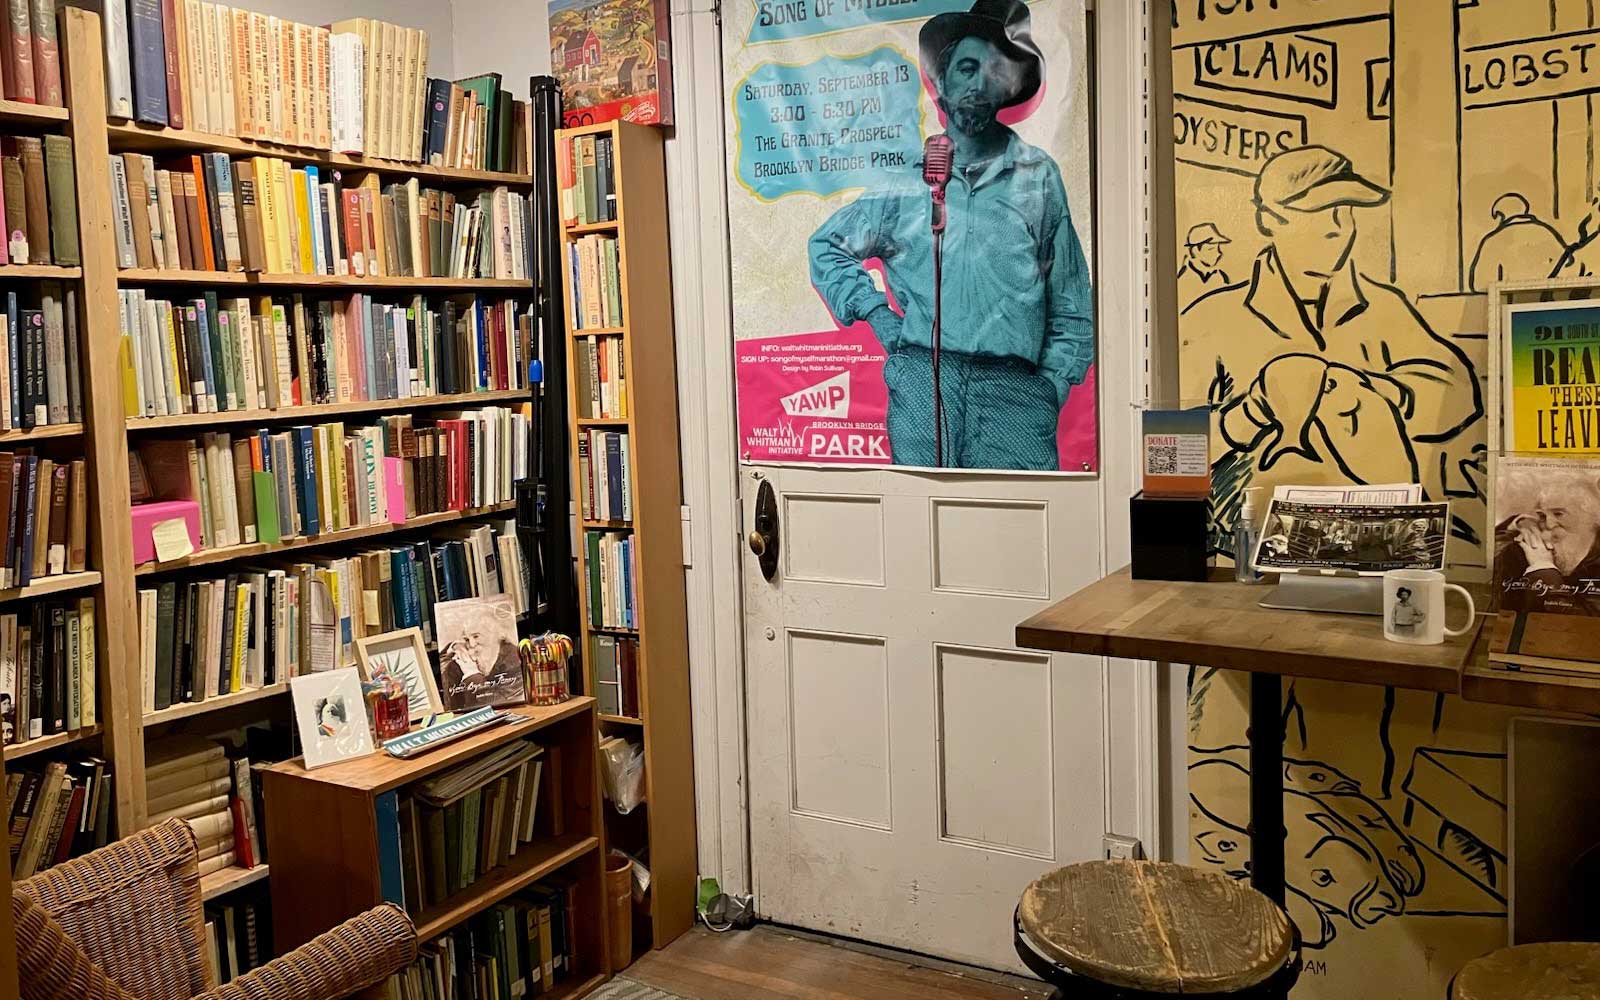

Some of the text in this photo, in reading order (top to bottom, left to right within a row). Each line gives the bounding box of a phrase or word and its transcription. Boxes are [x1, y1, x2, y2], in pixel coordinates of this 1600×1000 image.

[760, 1, 807, 27] SONG
[814, 0, 835, 17] OF
[1204, 43, 1328, 87] CLAMS
[1465, 44, 1597, 93] LOBST
[818, 73, 888, 93] SEPTEMBER
[893, 65, 910, 83] 13
[770, 105, 806, 124] 3:00
[822, 101, 856, 120] 6:30
[861, 98, 881, 116] PM
[754, 123, 903, 152] THE GRANITE PROSPECT
[1174, 112, 1293, 160] OYSTERS
[754, 151, 906, 178] BROOKLYN BRIDGE PARK
[1533, 346, 1600, 386] REA
[788, 385, 846, 413] YAWP
[753, 428, 778, 437] WALT
[812, 421, 885, 430] BROOKLYN BRIDGE
[747, 437, 791, 447] WHITMAN
[768, 447, 804, 455] INITIATIVE
[811, 434, 885, 456] PARK
[388, 735, 424, 755] WALT
